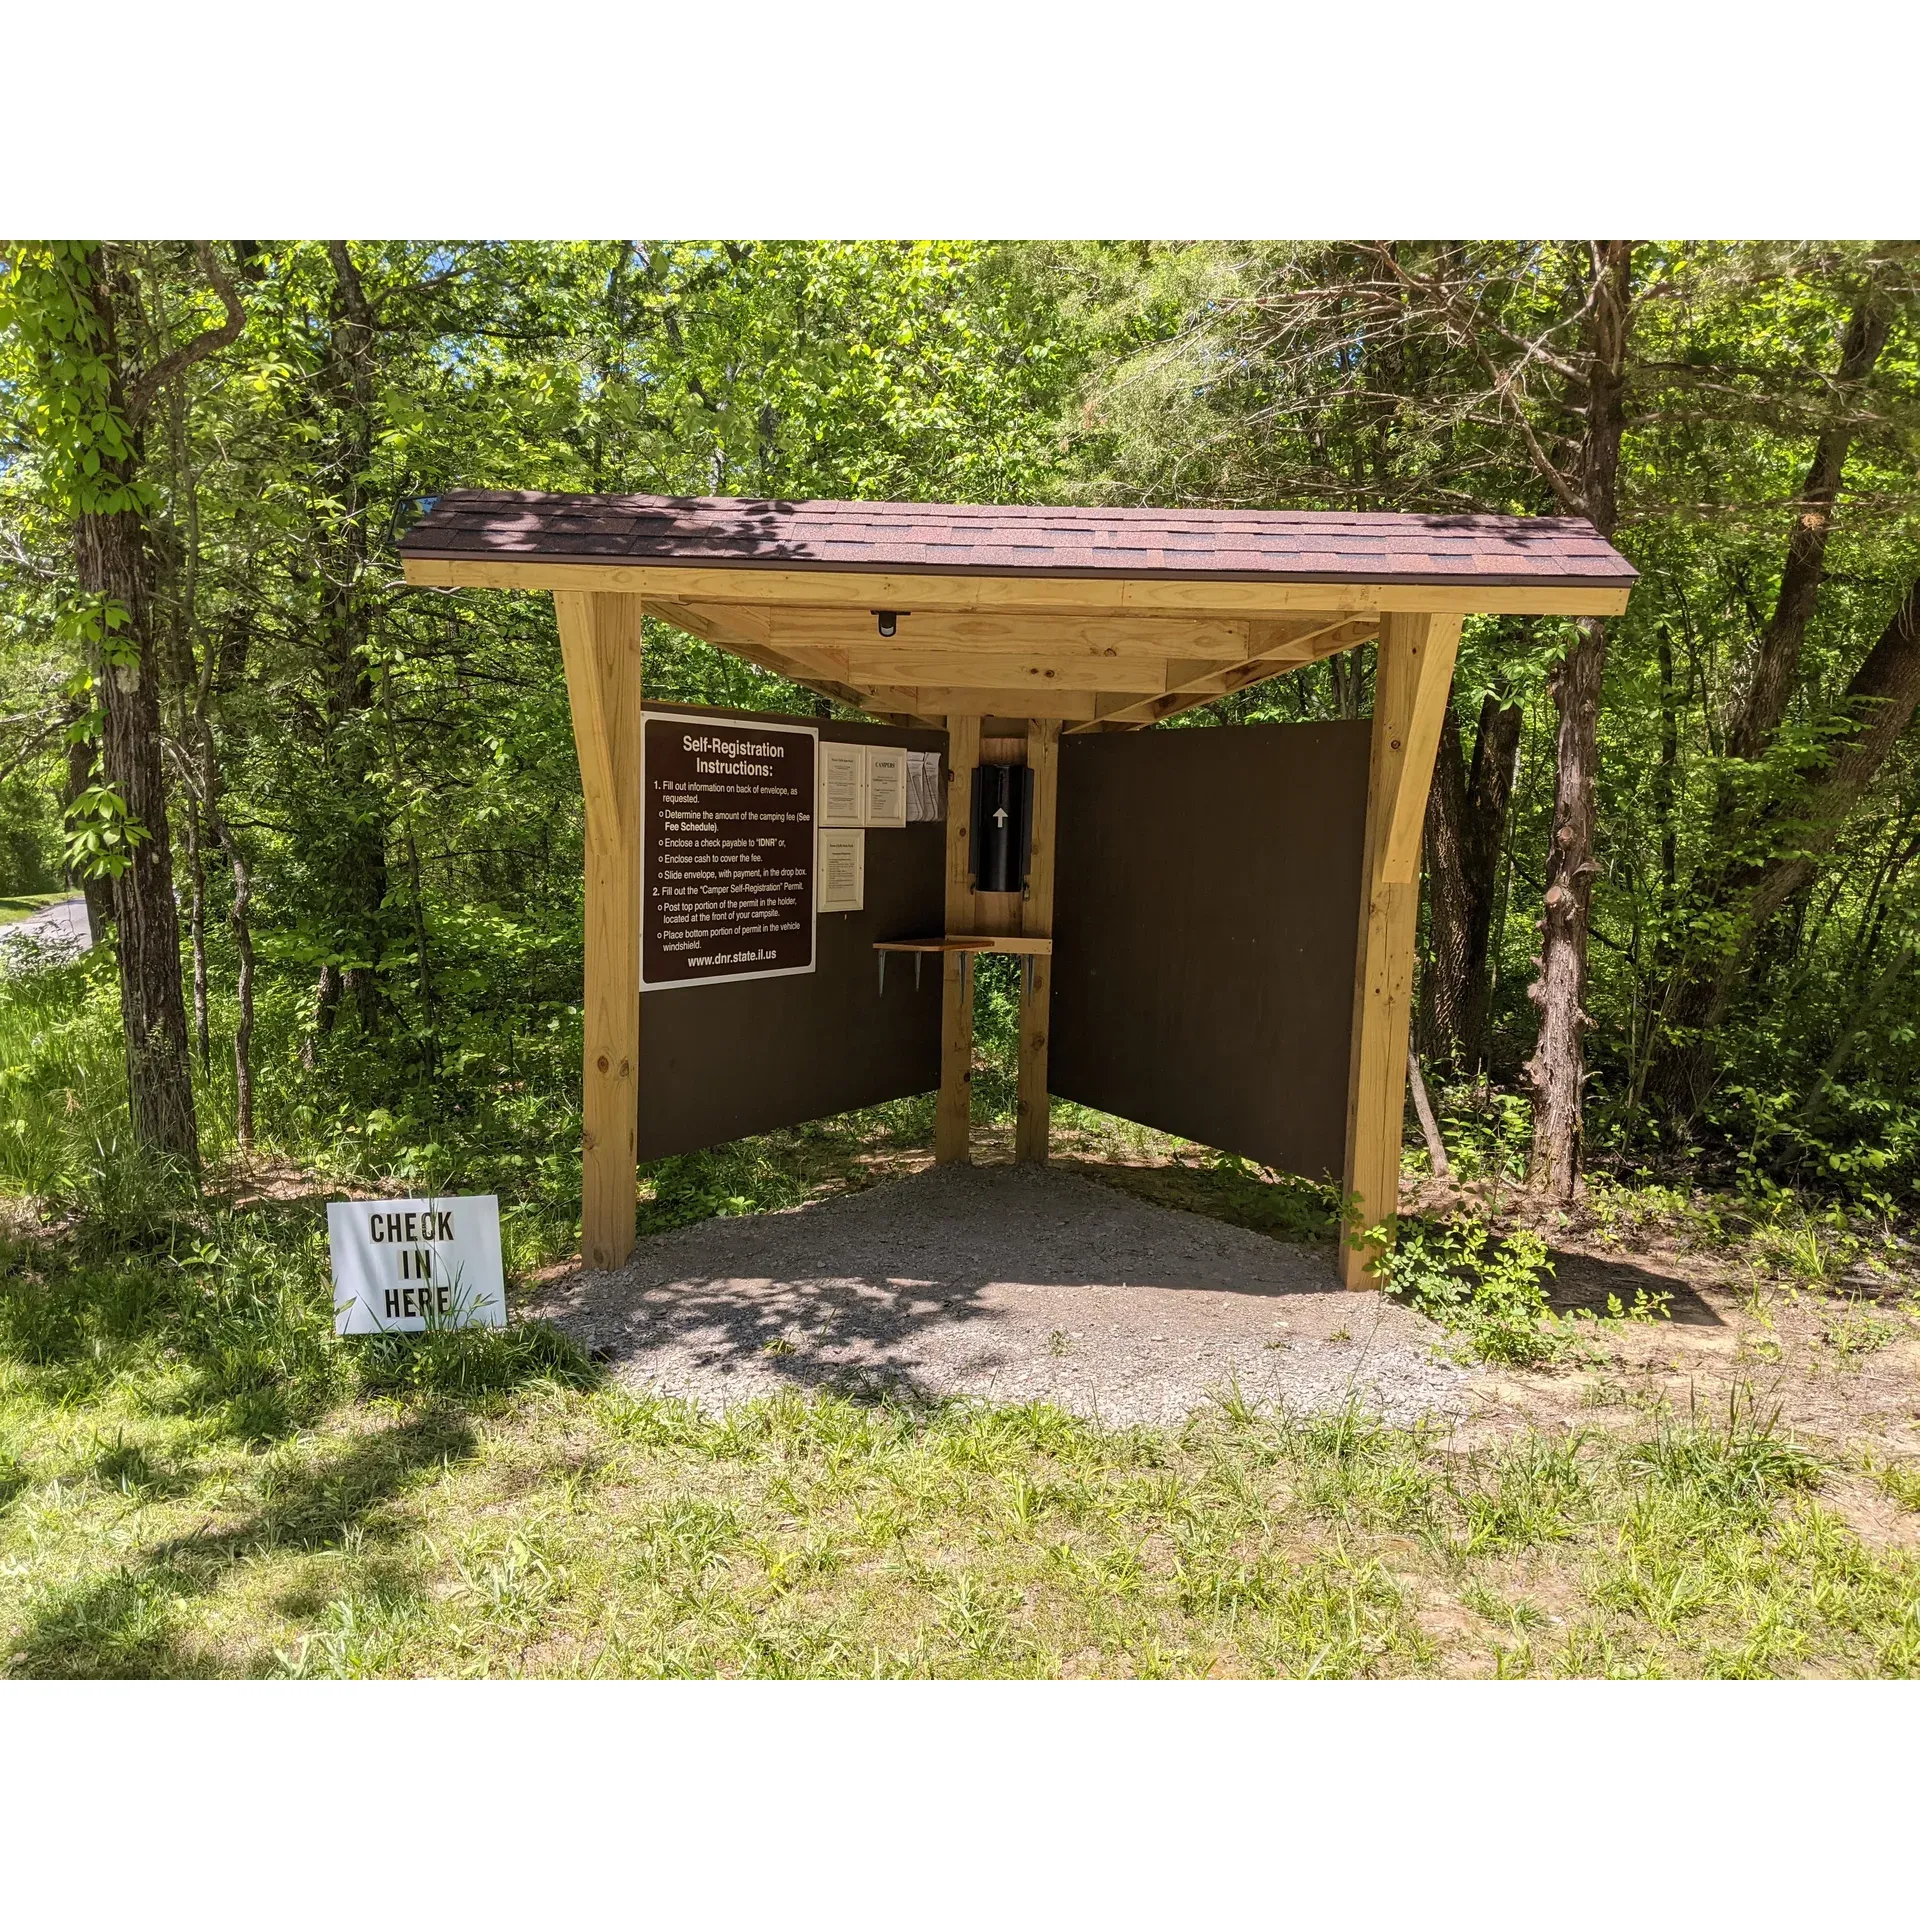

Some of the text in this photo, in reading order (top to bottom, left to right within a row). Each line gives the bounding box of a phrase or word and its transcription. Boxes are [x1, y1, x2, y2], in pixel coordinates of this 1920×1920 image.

[683, 735, 784, 758] Self-Registration
[697, 757, 772, 776] Instructions:
[654, 780, 661, 789] 1.
[663, 781, 673, 790] Fill
[675, 782, 686, 790] out
[688, 782, 725, 792] information
[736, 784, 751, 793] back
[753, 785, 759, 793] of
[760, 786, 789, 796] envelope,
[663, 794, 699, 804] requested.
[665, 810, 810, 822] Determine the amount of the camping fee (See
[665, 822, 718, 833] Fee Schedule).
[665, 838, 693, 847] Enclose
[701, 838, 720, 847] check
[722, 838, 747, 849] payable
[749, 839, 755, 847] to
[665, 854, 693, 863] Enclose
[694, 854, 710, 863] cash
[740, 854, 749, 862] the
[751, 853, 762, 862] fee.
[664, 870, 682, 879] Slide
[684, 870, 717, 880] envelope,
[718, 869, 732, 878] with
[733, 869, 761, 879] payment,
[763, 868, 769, 876] in
[770, 868, 779, 876] the
[781, 868, 794, 877] drop
[653, 887, 660, 896] 2.
[662, 887, 672, 895] Fill
[674, 887, 685, 895] out
[687, 886, 698, 894] the
[784, 882, 803, 890] Permit.
[664, 897, 797, 912] Post top portion of the permit in the holder,
[664, 909, 780, 923] located at the front of your campsite.
[664, 922, 800, 939] Place bottom portion of permit in the vehicle
[663, 941, 701, 951] windshield.
[687, 948, 776, 967] www.dnr.state.il.us
[371, 1212, 454, 1242] CHECK
[402, 1250, 431, 1279] IN
[385, 1287, 450, 1318] HERE
